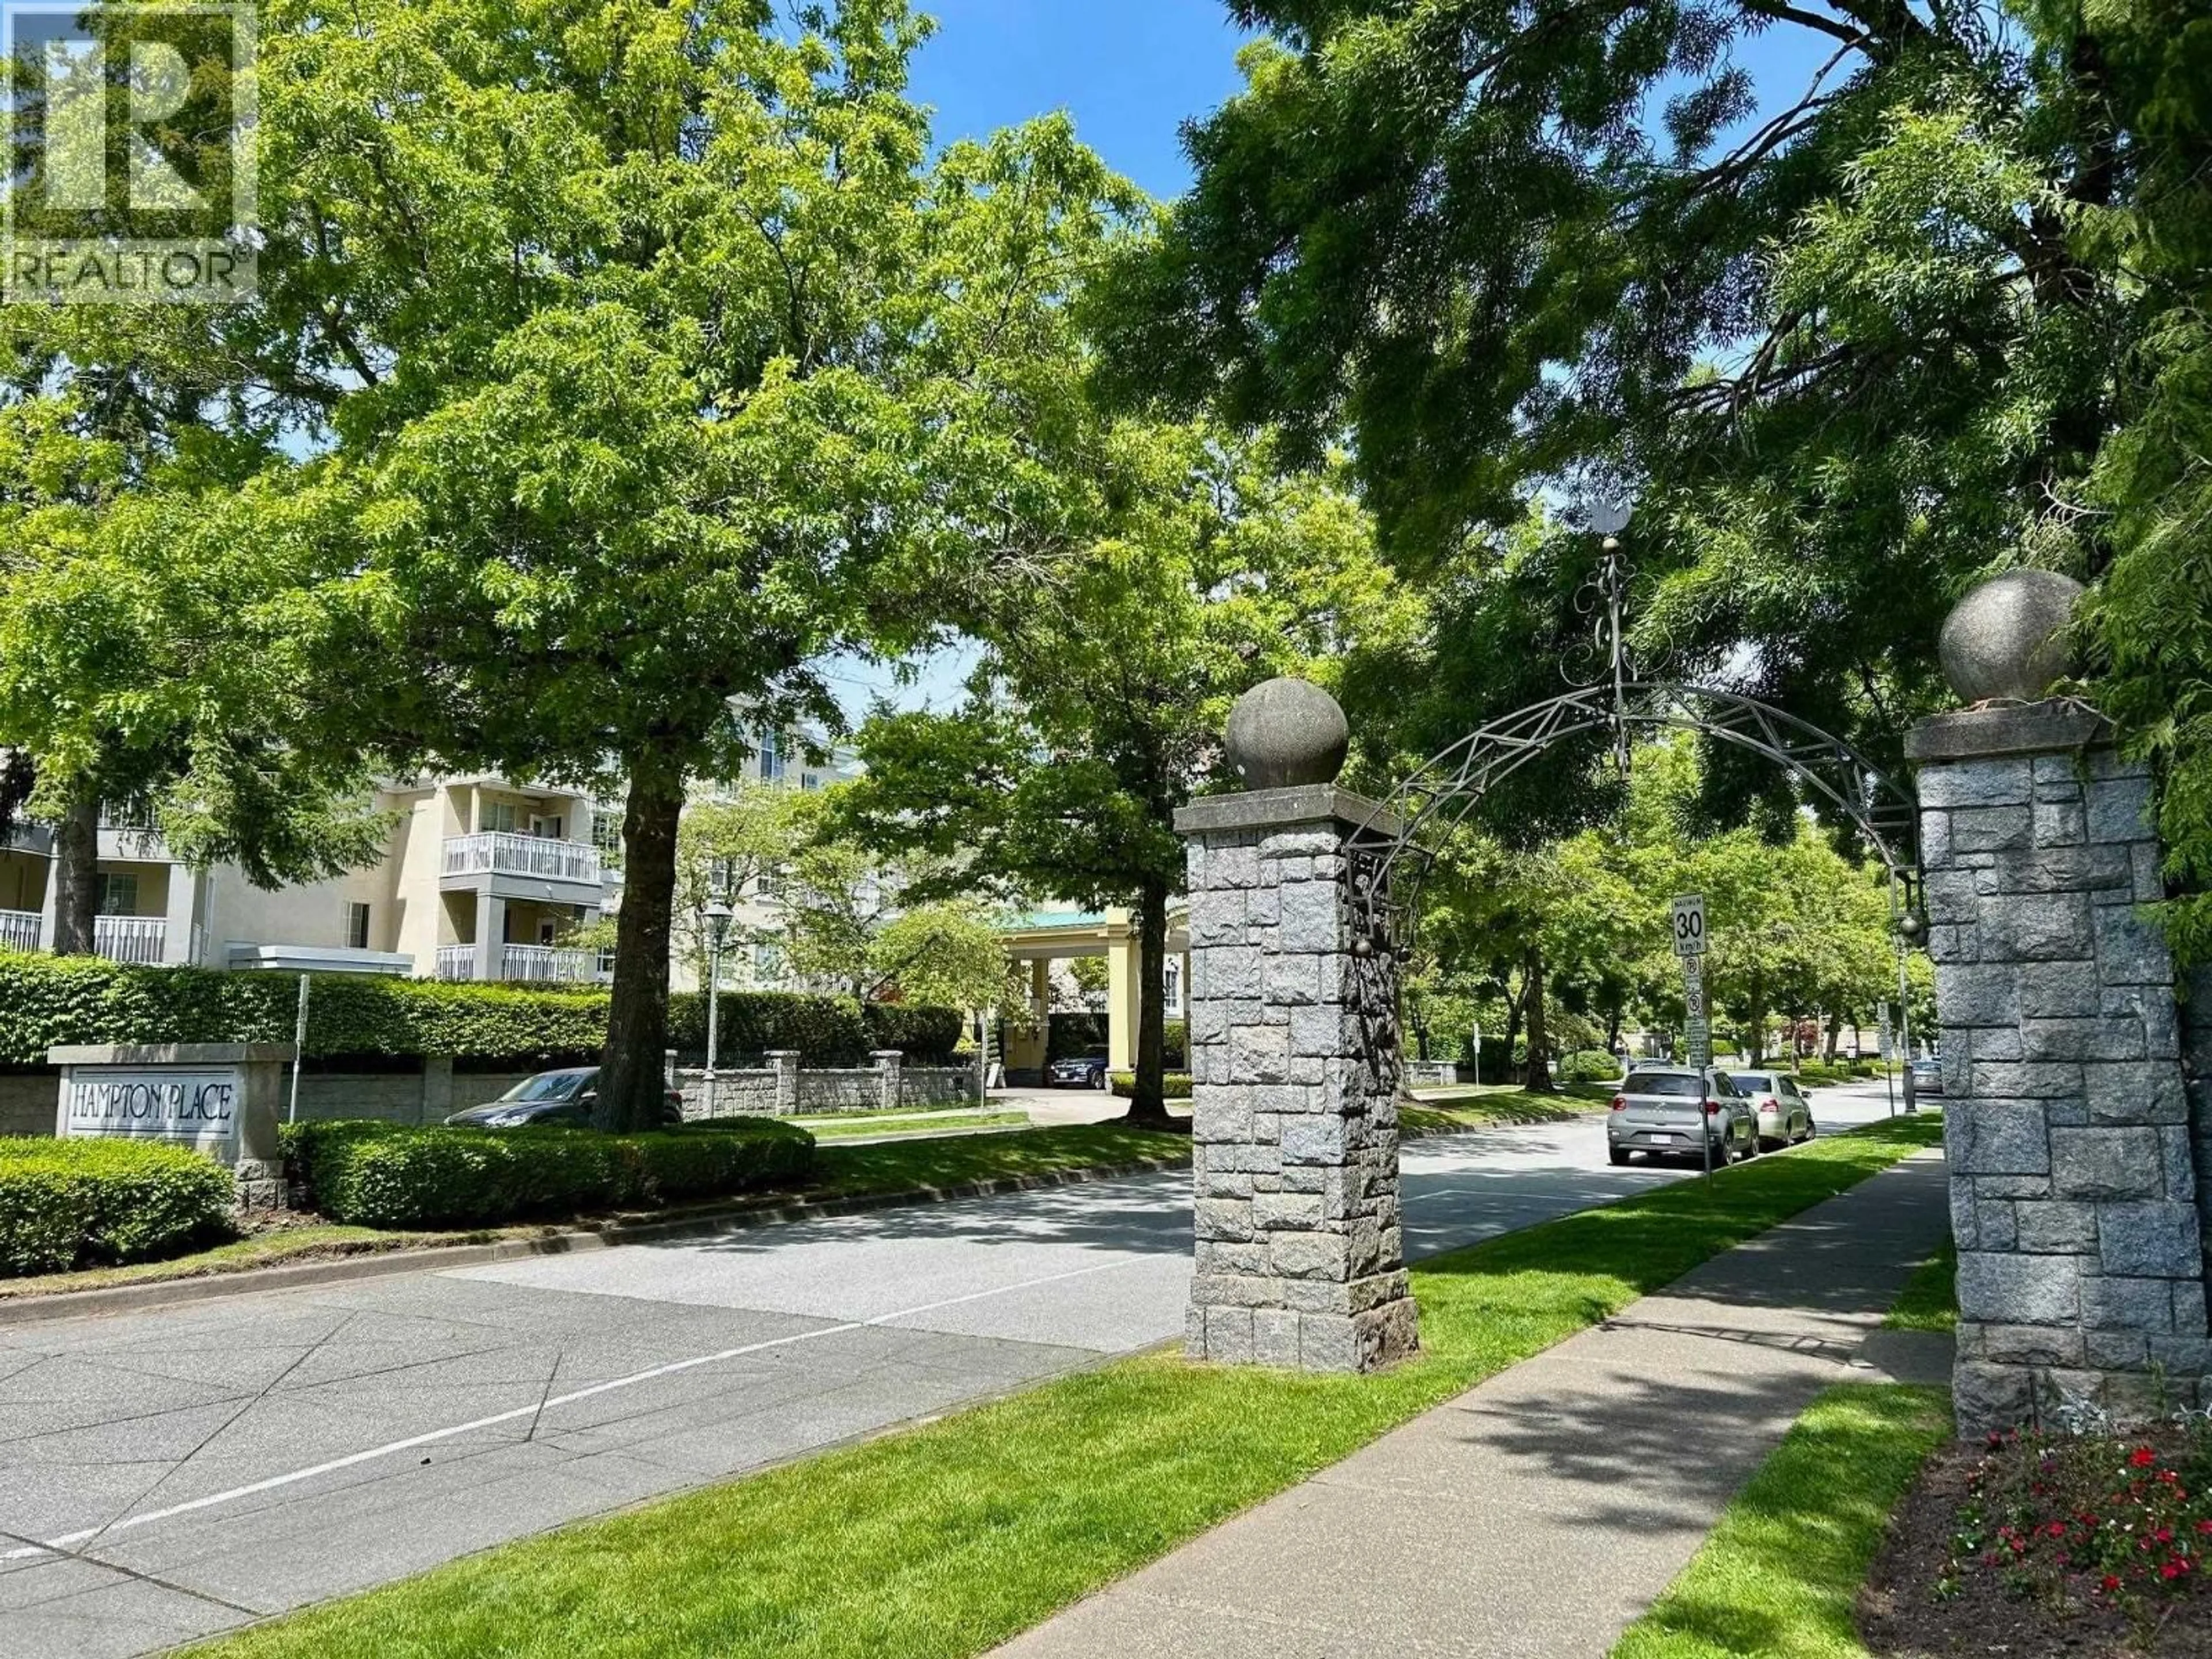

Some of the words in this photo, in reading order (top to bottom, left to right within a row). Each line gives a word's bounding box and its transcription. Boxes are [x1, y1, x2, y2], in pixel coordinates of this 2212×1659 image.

[1677, 911, 1701, 939] 30
[73, 1084, 162, 1119] HAMPTON
[168, 1084, 233, 1120] PLACE
